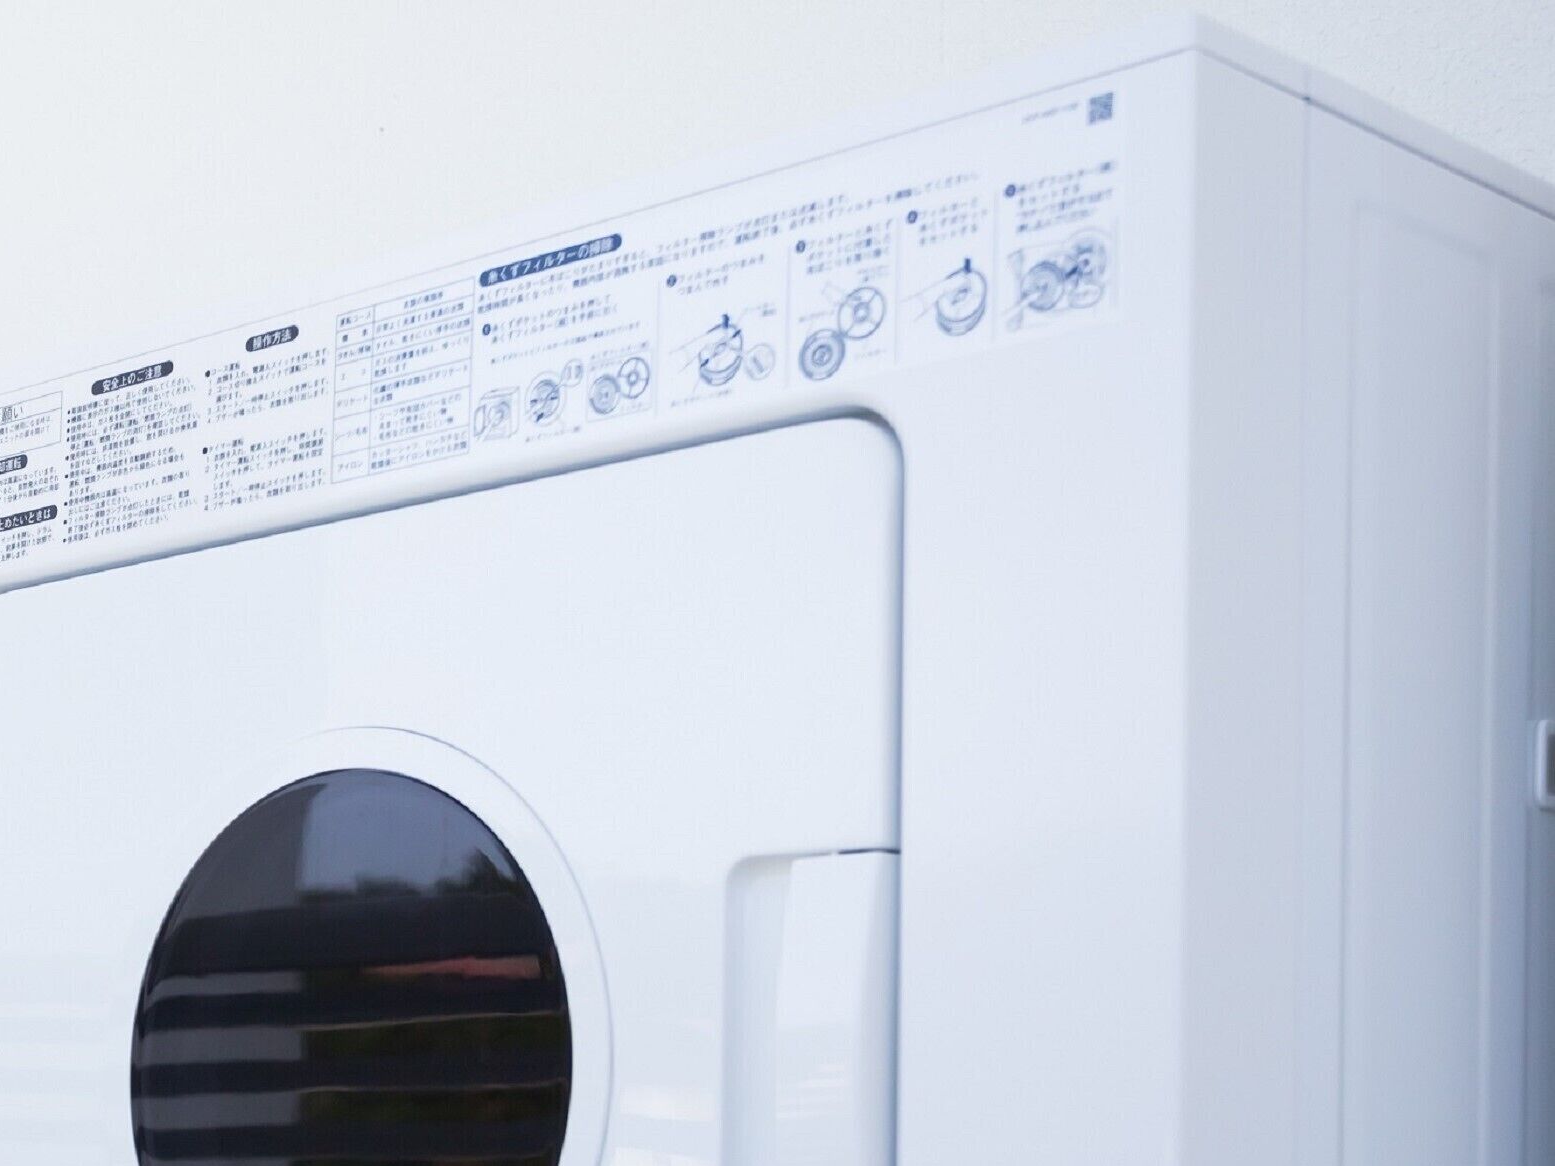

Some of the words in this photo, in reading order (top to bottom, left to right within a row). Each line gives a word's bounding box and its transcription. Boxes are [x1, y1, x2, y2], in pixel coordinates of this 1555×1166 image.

[252, 327, 292, 351] 操作方法
[102, 363, 161, 393] 安全上のご注意
